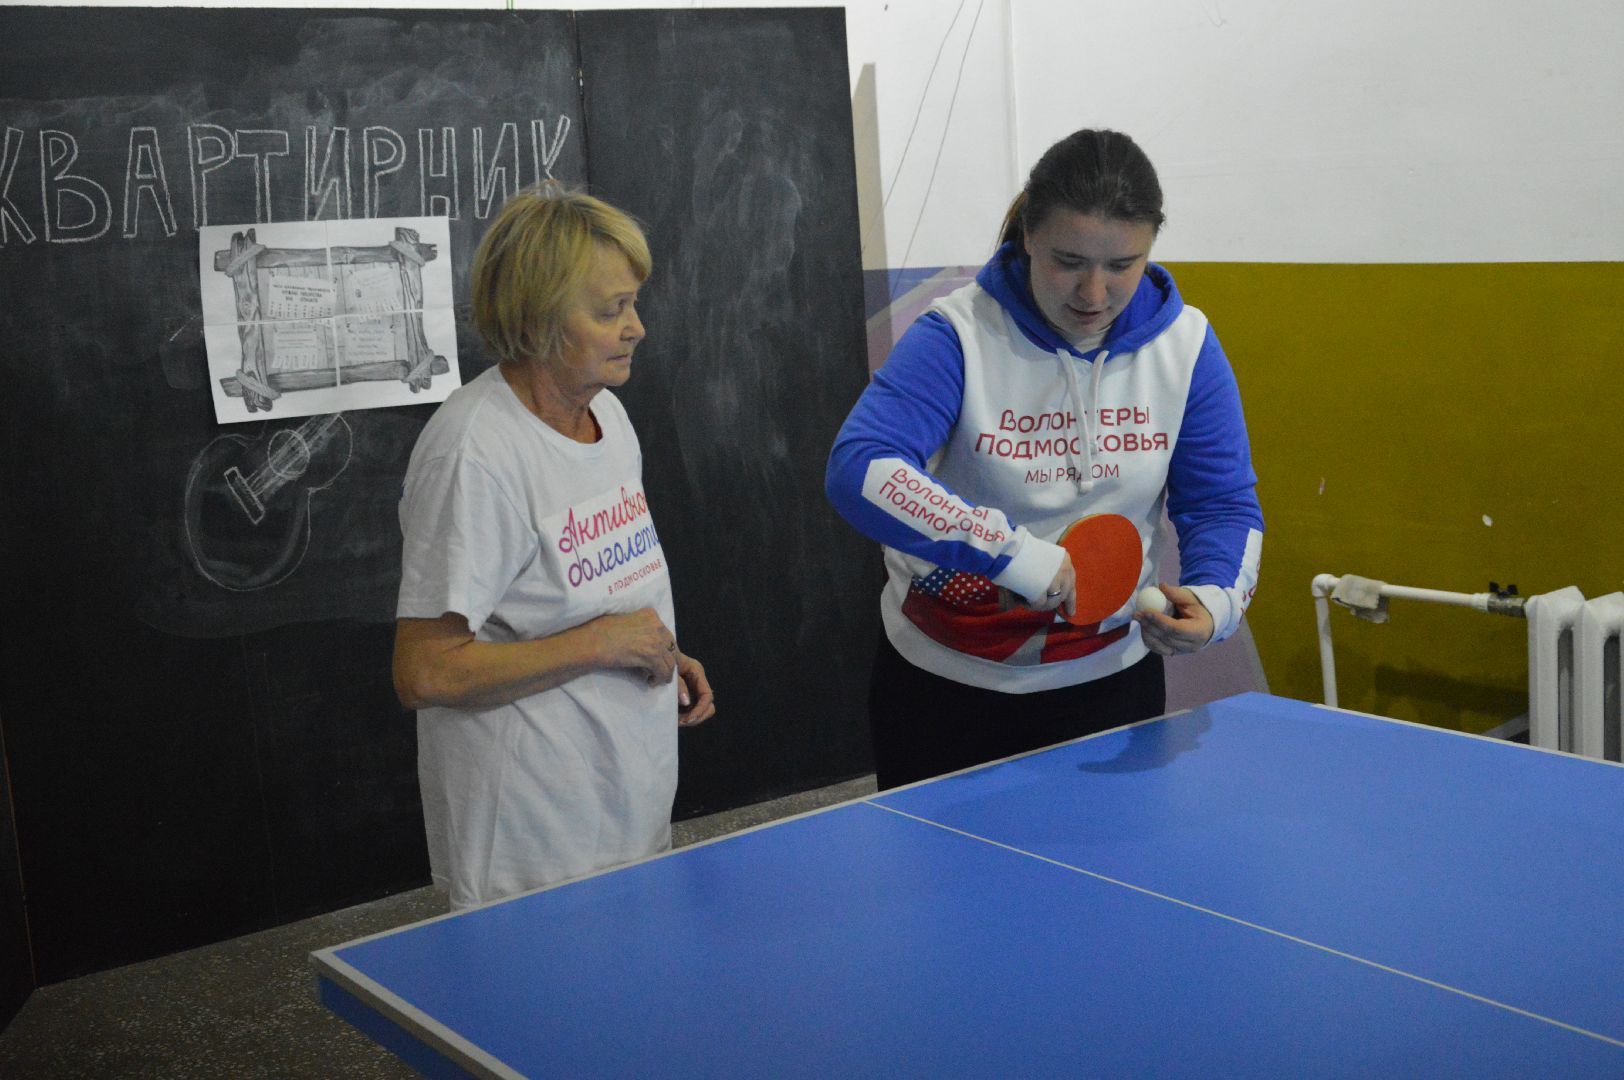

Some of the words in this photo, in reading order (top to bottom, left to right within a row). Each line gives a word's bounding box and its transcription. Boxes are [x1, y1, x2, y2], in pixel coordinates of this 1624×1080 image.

[999, 406, 1150, 433] ВОЛОНЕРЫ
[974, 432, 1169, 460] ПОДМОСОВЬЯ
[1024, 468, 1052, 484] МЫ
[890, 468, 989, 521] ВОЛОНТЫ
[879, 480, 1005, 542] ПОДМОСОВЬЯ
